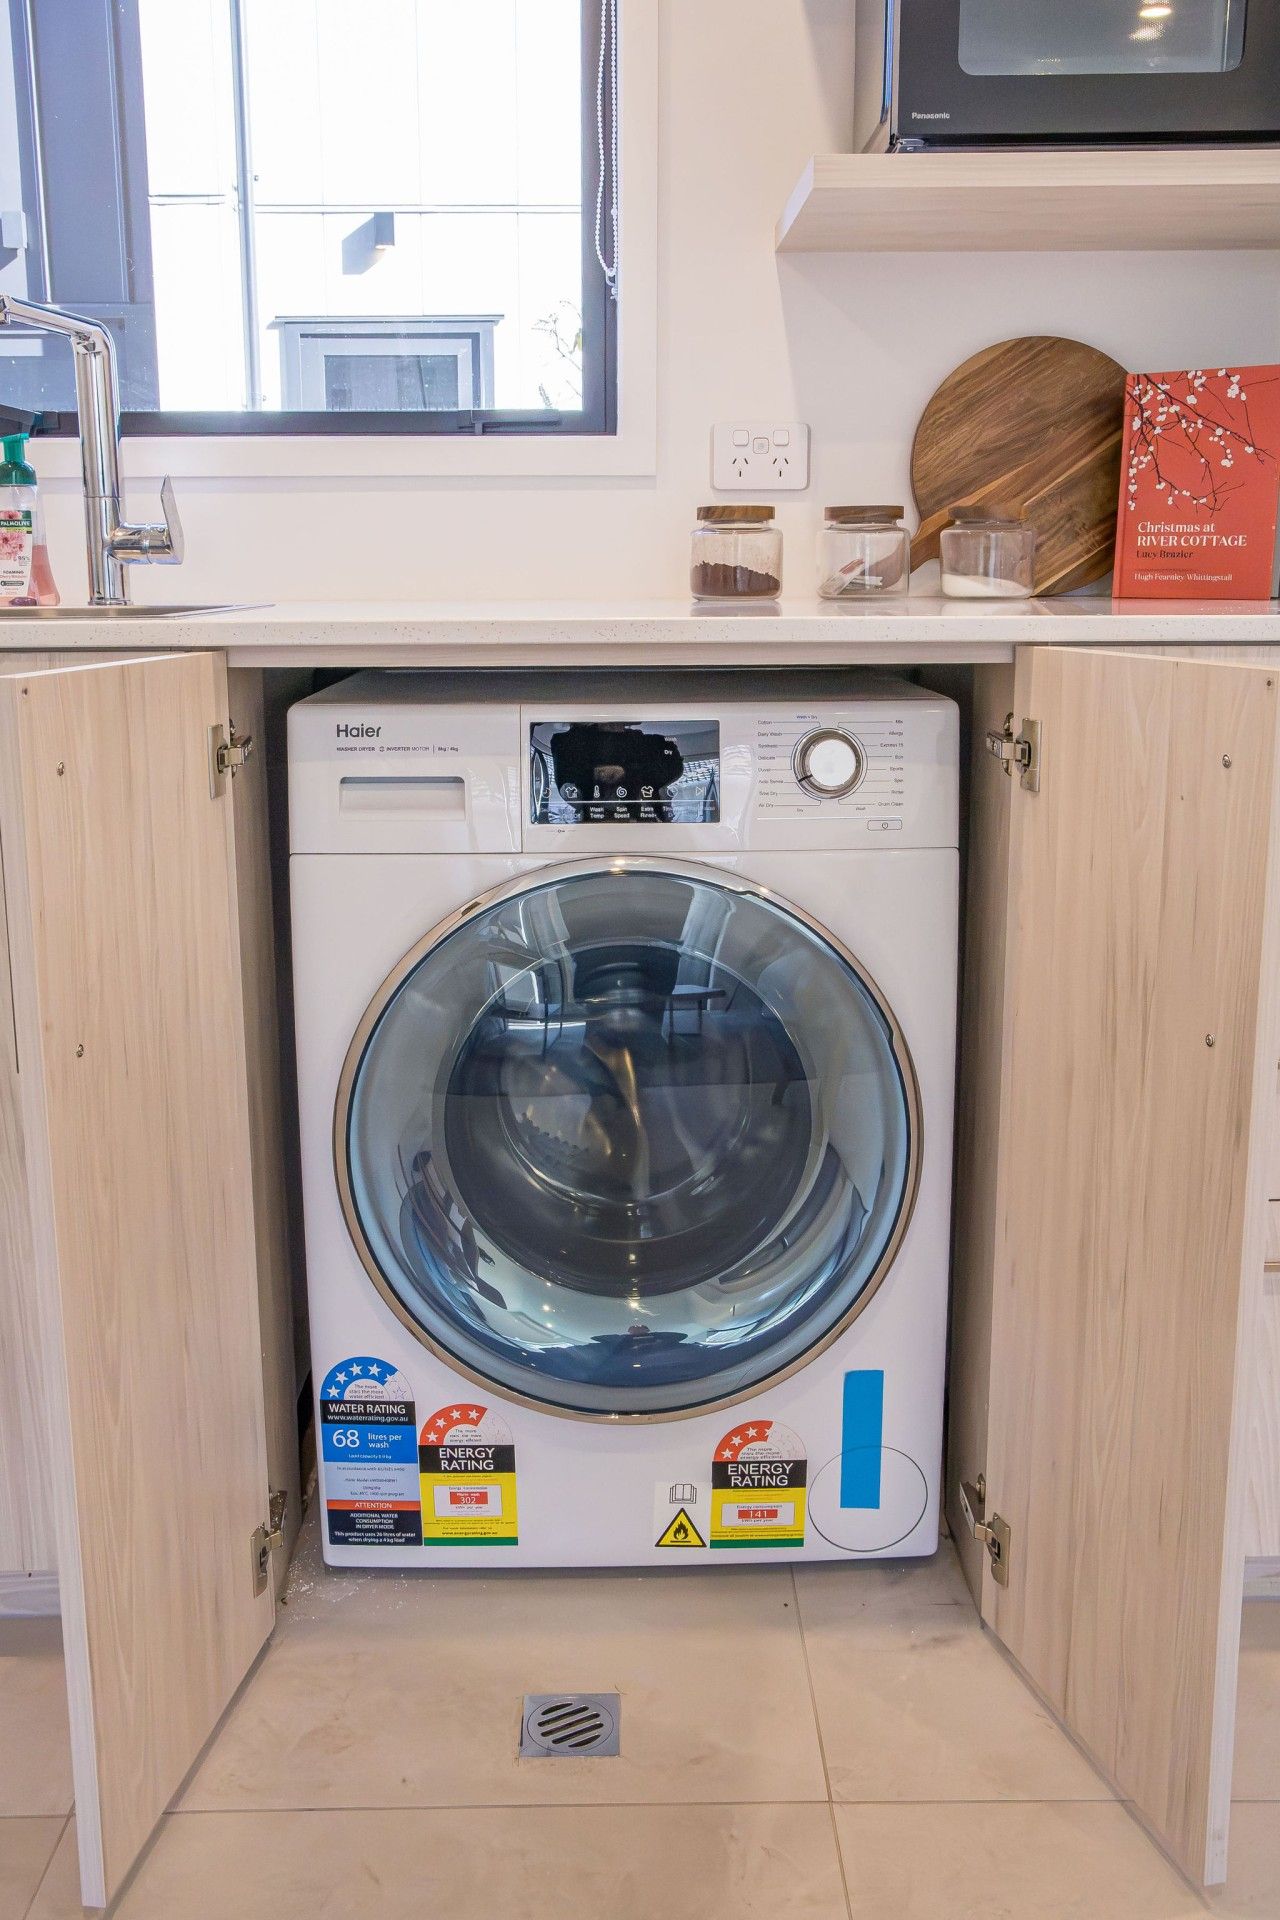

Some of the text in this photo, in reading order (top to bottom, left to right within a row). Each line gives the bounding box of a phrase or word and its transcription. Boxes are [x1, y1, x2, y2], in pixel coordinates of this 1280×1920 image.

[911, 111, 951, 120] Panasonic
[1137, 521, 1215, 533] Christmas at
[1136, 534, 1248, 547] RIVER COTTAGE
[1136, 550, 1194, 560] Lucy Brazier
[1134, 573, 1154, 581] Hugh
[336, 723, 382, 738] Haier
[328, 1403, 406, 1414] WATER RATING
[327, 1414, 409, 1423] www.waterrating.gov.au
[332, 1429, 360, 1448] 68
[367, 1432, 402, 1443] litres per
[368, 1441, 390, 1449] wash
[439, 1447, 495, 1459] ENERGY
[441, 1460, 494, 1471] RATING
[727, 1462, 794, 1476] ENERGY
[730, 1475, 789, 1487] RATING
[460, 1496, 476, 1504] 302
[749, 1510, 767, 1519] 141
